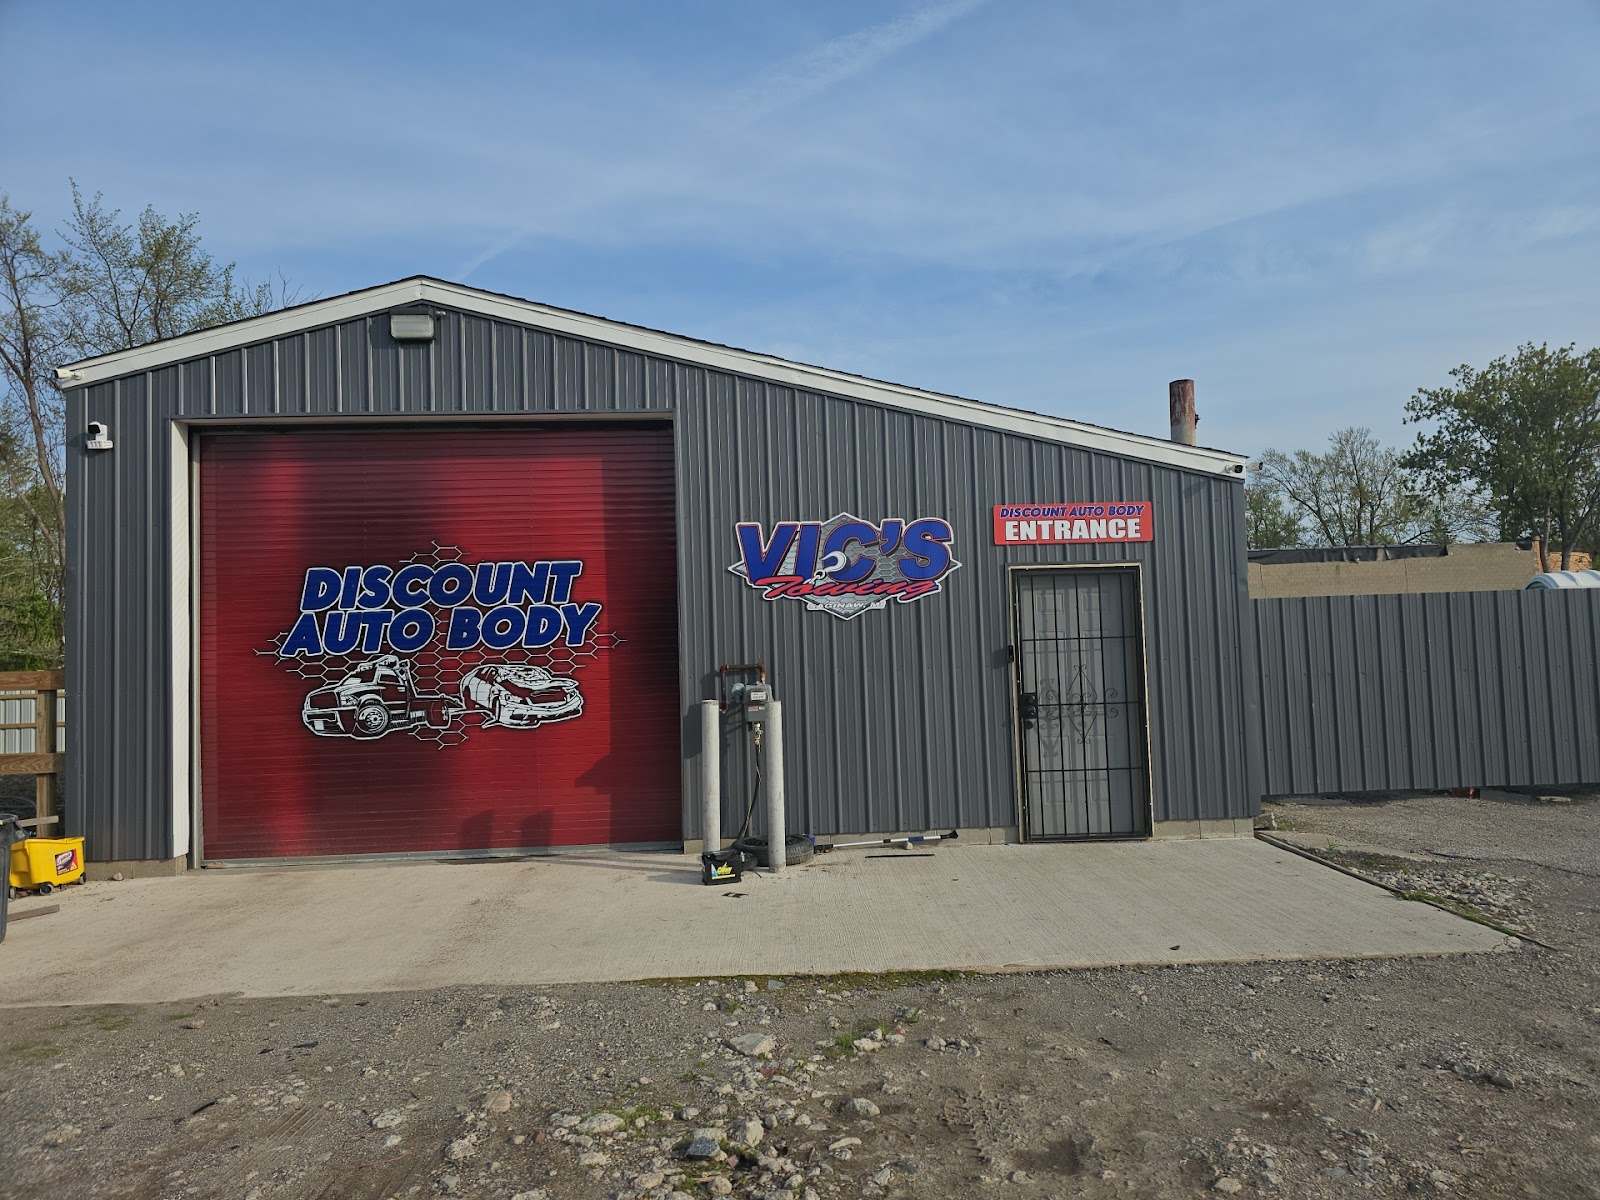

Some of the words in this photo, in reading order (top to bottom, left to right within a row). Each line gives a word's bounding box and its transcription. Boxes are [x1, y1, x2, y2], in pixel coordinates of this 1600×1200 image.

[1000, 506, 1067, 518] DISCOUNT
[1069, 505, 1105, 517] AUTO
[1108, 504, 1145, 516] BODY
[1005, 518, 1141, 541] ENTRANCE
[736, 518, 952, 584] VIC'S
[300, 561, 582, 611] DISCOUNT
[754, 575, 939, 601] Towing
[281, 609, 435, 656] AUTO
[446, 603, 601, 649] BODY
